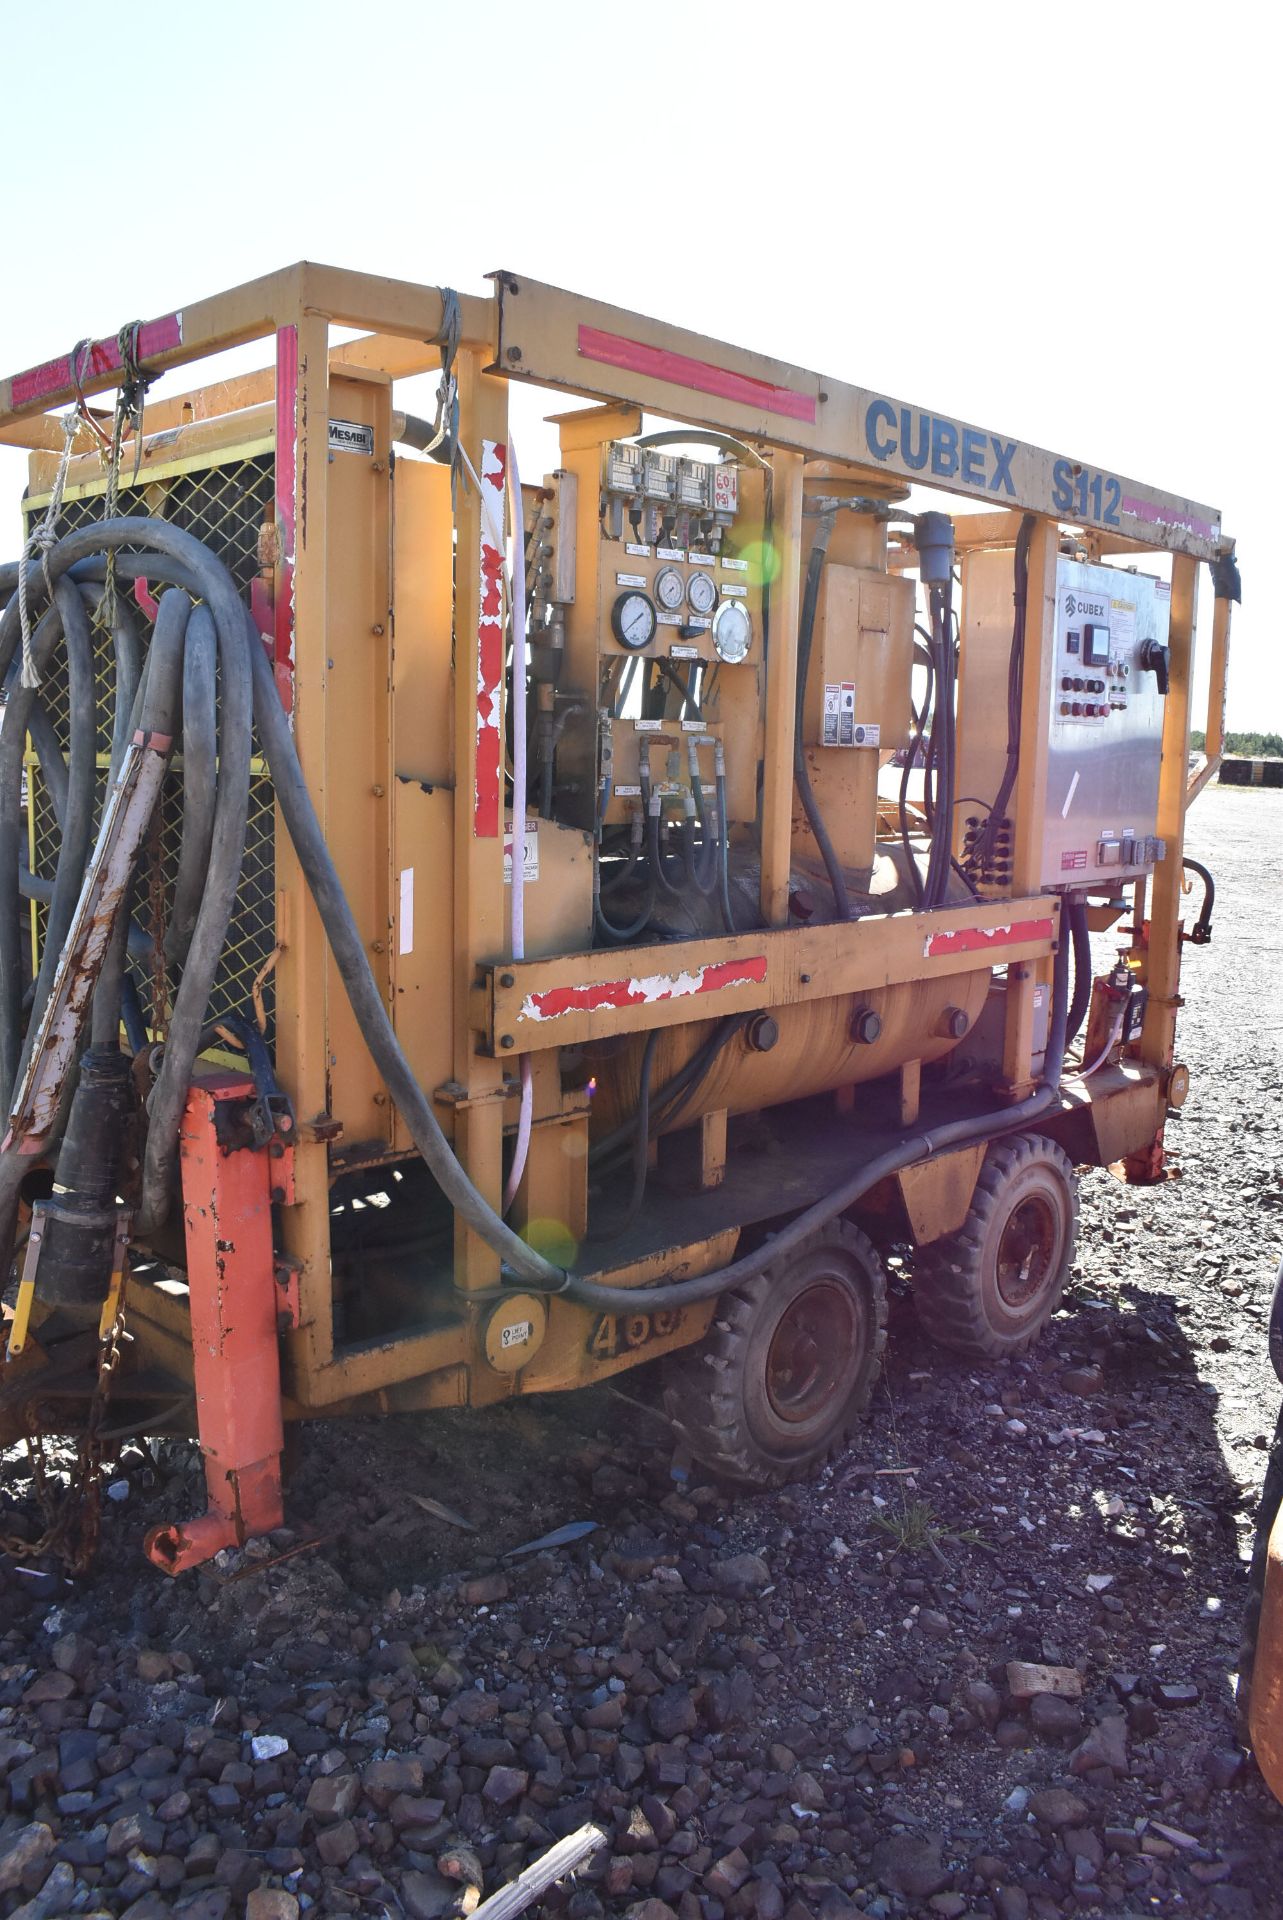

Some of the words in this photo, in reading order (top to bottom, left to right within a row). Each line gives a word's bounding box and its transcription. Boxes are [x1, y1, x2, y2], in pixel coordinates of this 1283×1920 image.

[328, 426, 366, 444] MESABI
[865, 399, 1018, 497] CUBEX
[1052, 459, 1122, 526] S112
[716, 473, 730, 490] 60
[1077, 602, 1105, 616] CUBEX
[511, 1326, 523, 1335] LIFT
[511, 1330, 528, 1341] POINT
